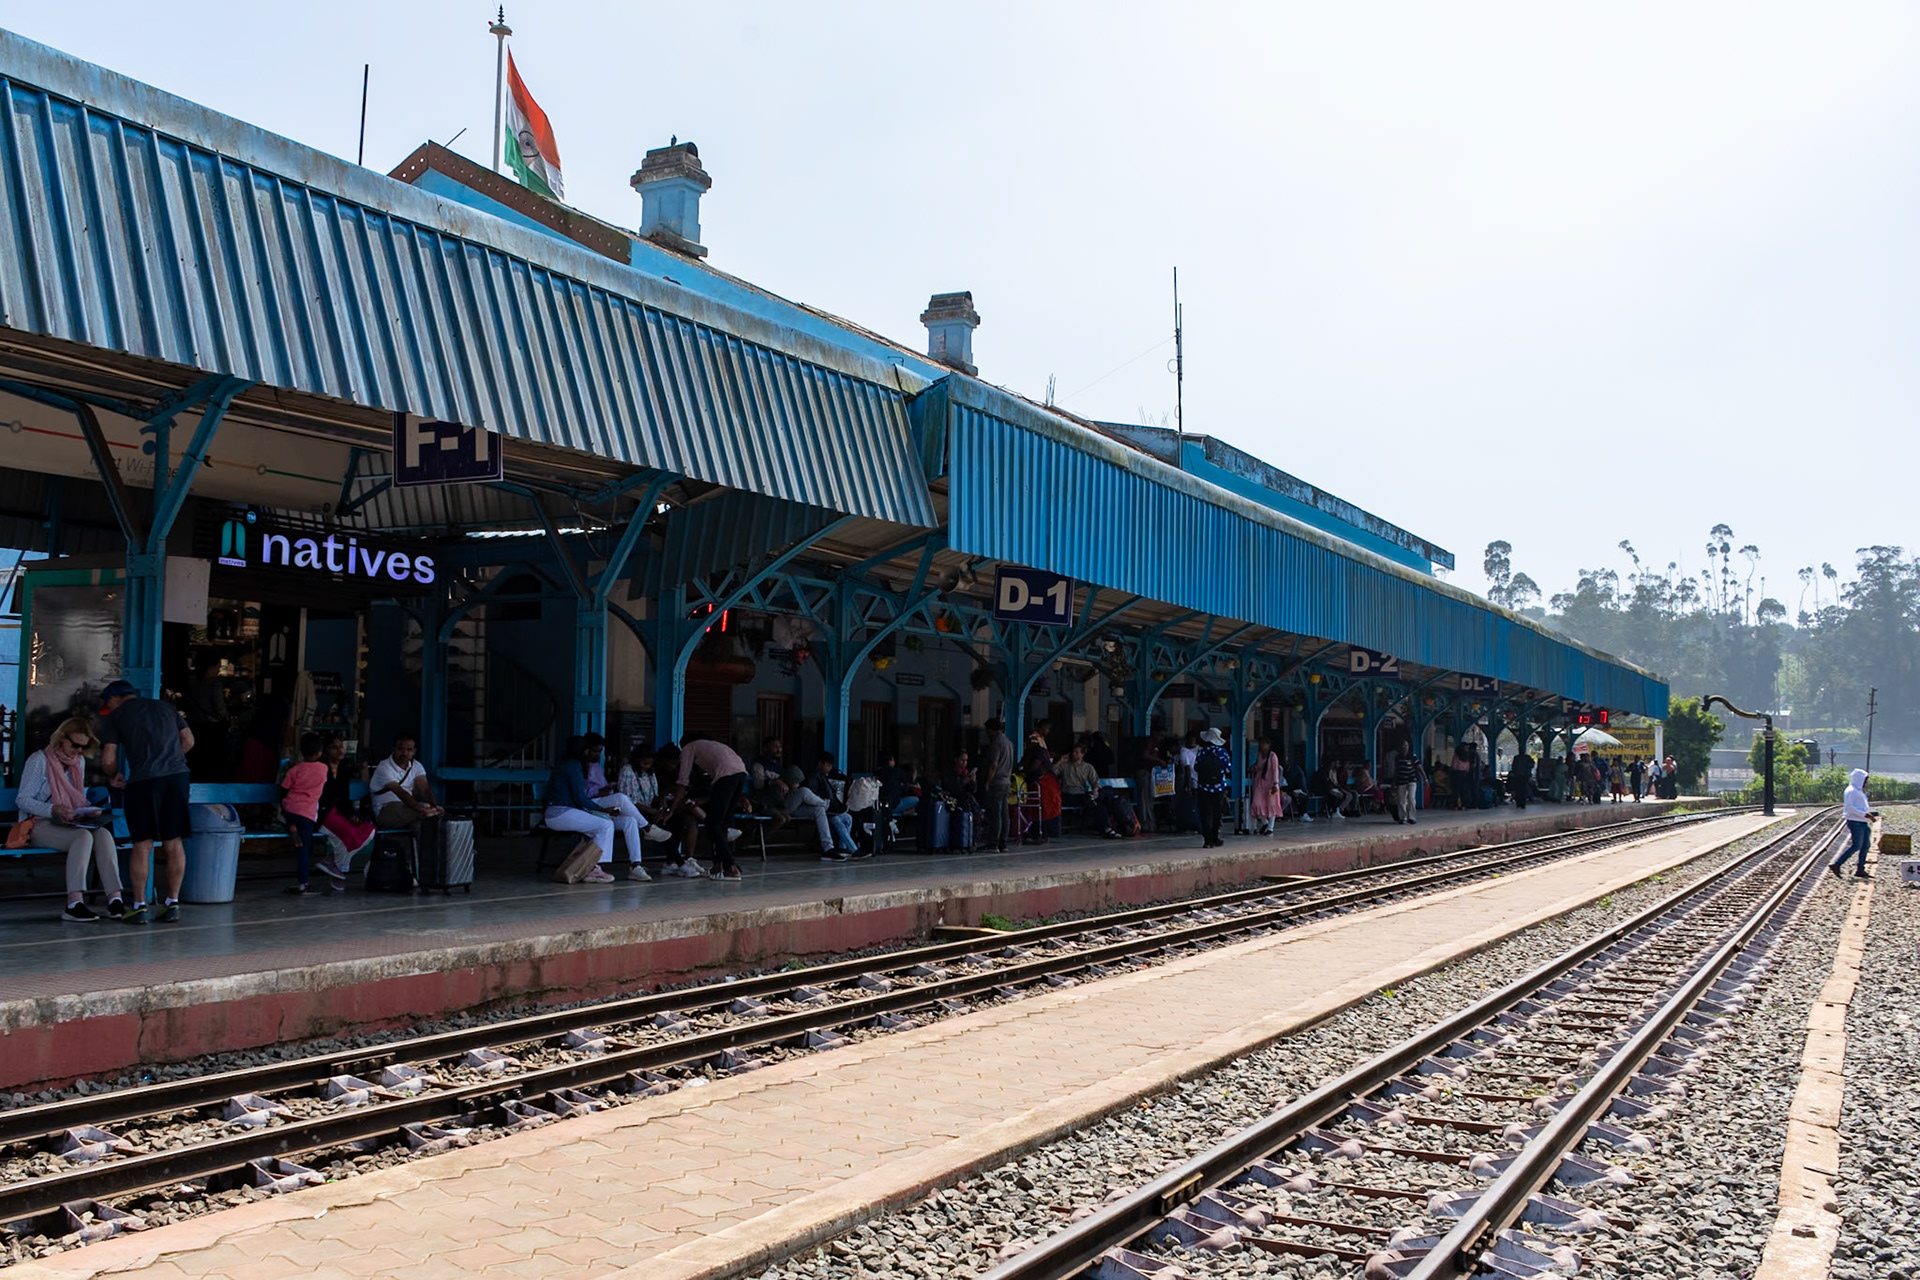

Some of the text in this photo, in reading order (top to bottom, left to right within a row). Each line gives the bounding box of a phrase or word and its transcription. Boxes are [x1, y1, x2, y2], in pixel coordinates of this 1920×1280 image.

[406, 412, 489, 468] F-1
[262, 532, 436, 585] natives
[999, 577, 1067, 615] D-1
[1350, 651, 1398, 672] D-2
[1461, 678, 1498, 691] DL-1
[1562, 700, 1591, 713] F-2
